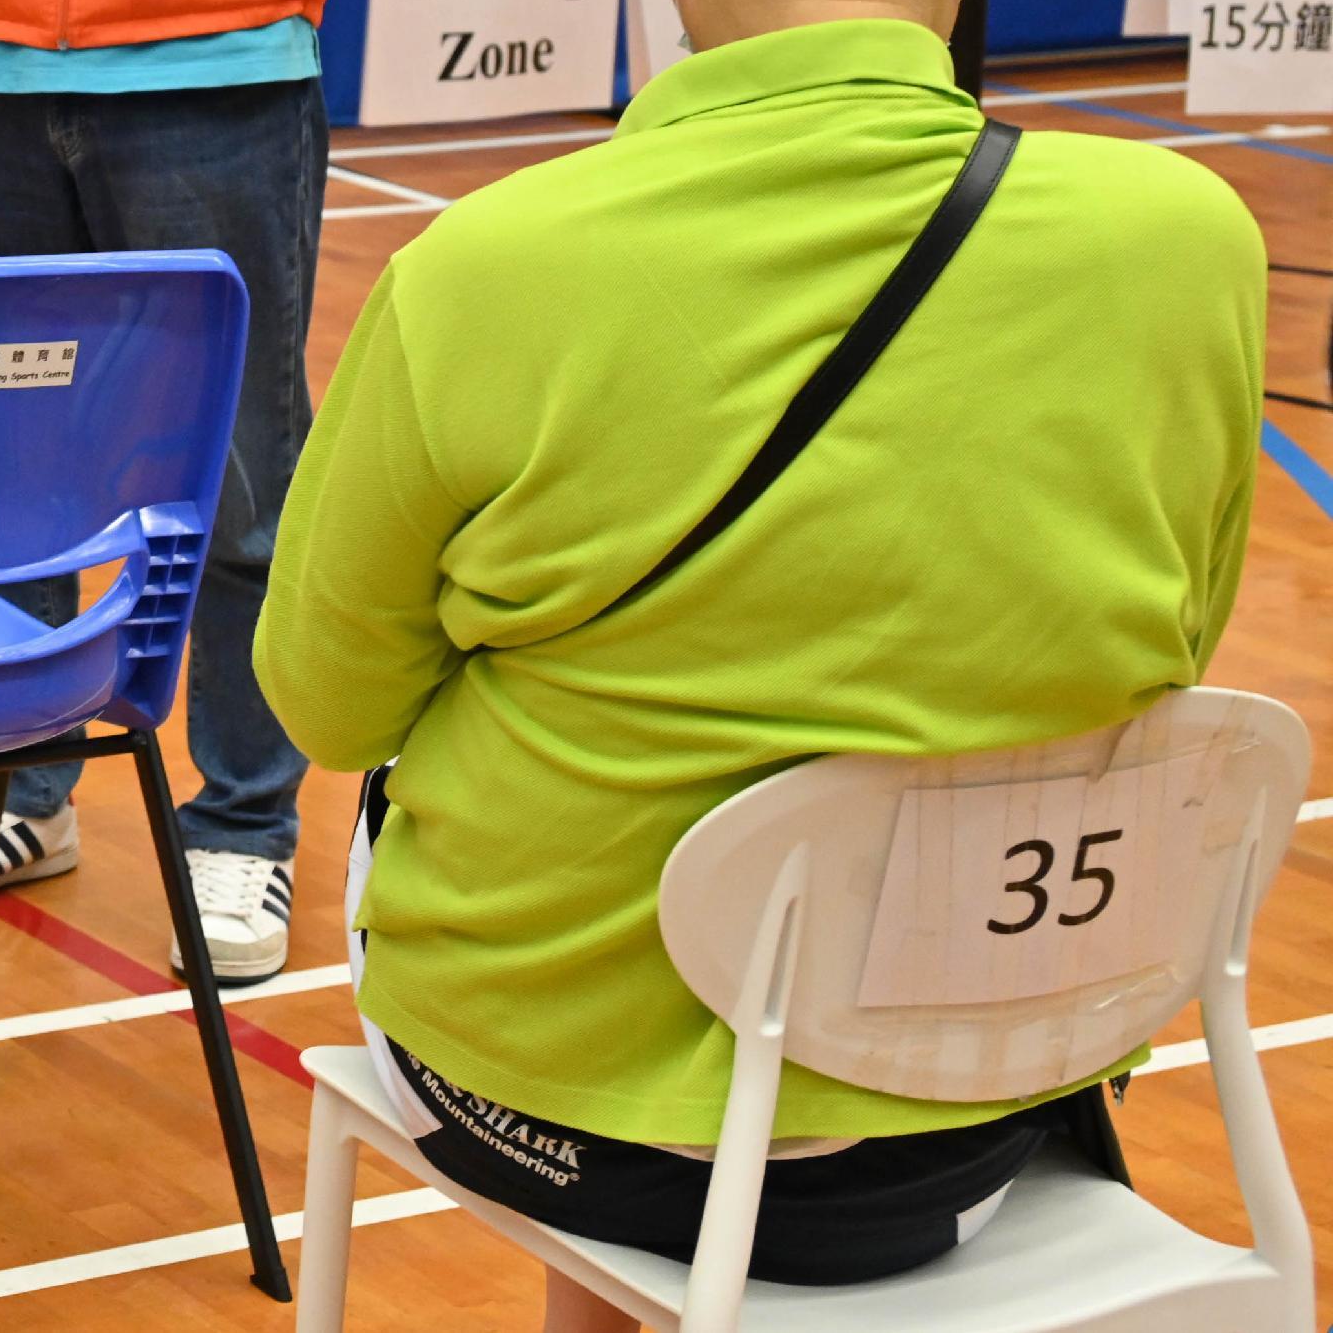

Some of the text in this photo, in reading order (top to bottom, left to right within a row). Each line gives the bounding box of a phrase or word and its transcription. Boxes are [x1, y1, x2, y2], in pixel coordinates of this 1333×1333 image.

[1200, 0, 1333, 52] 15分鐘
[437, 31, 554, 83] Zone
[11, 371, 38, 381] Sports
[42, 370, 70, 379] Centre
[987, 829, 1123, 935] 35
